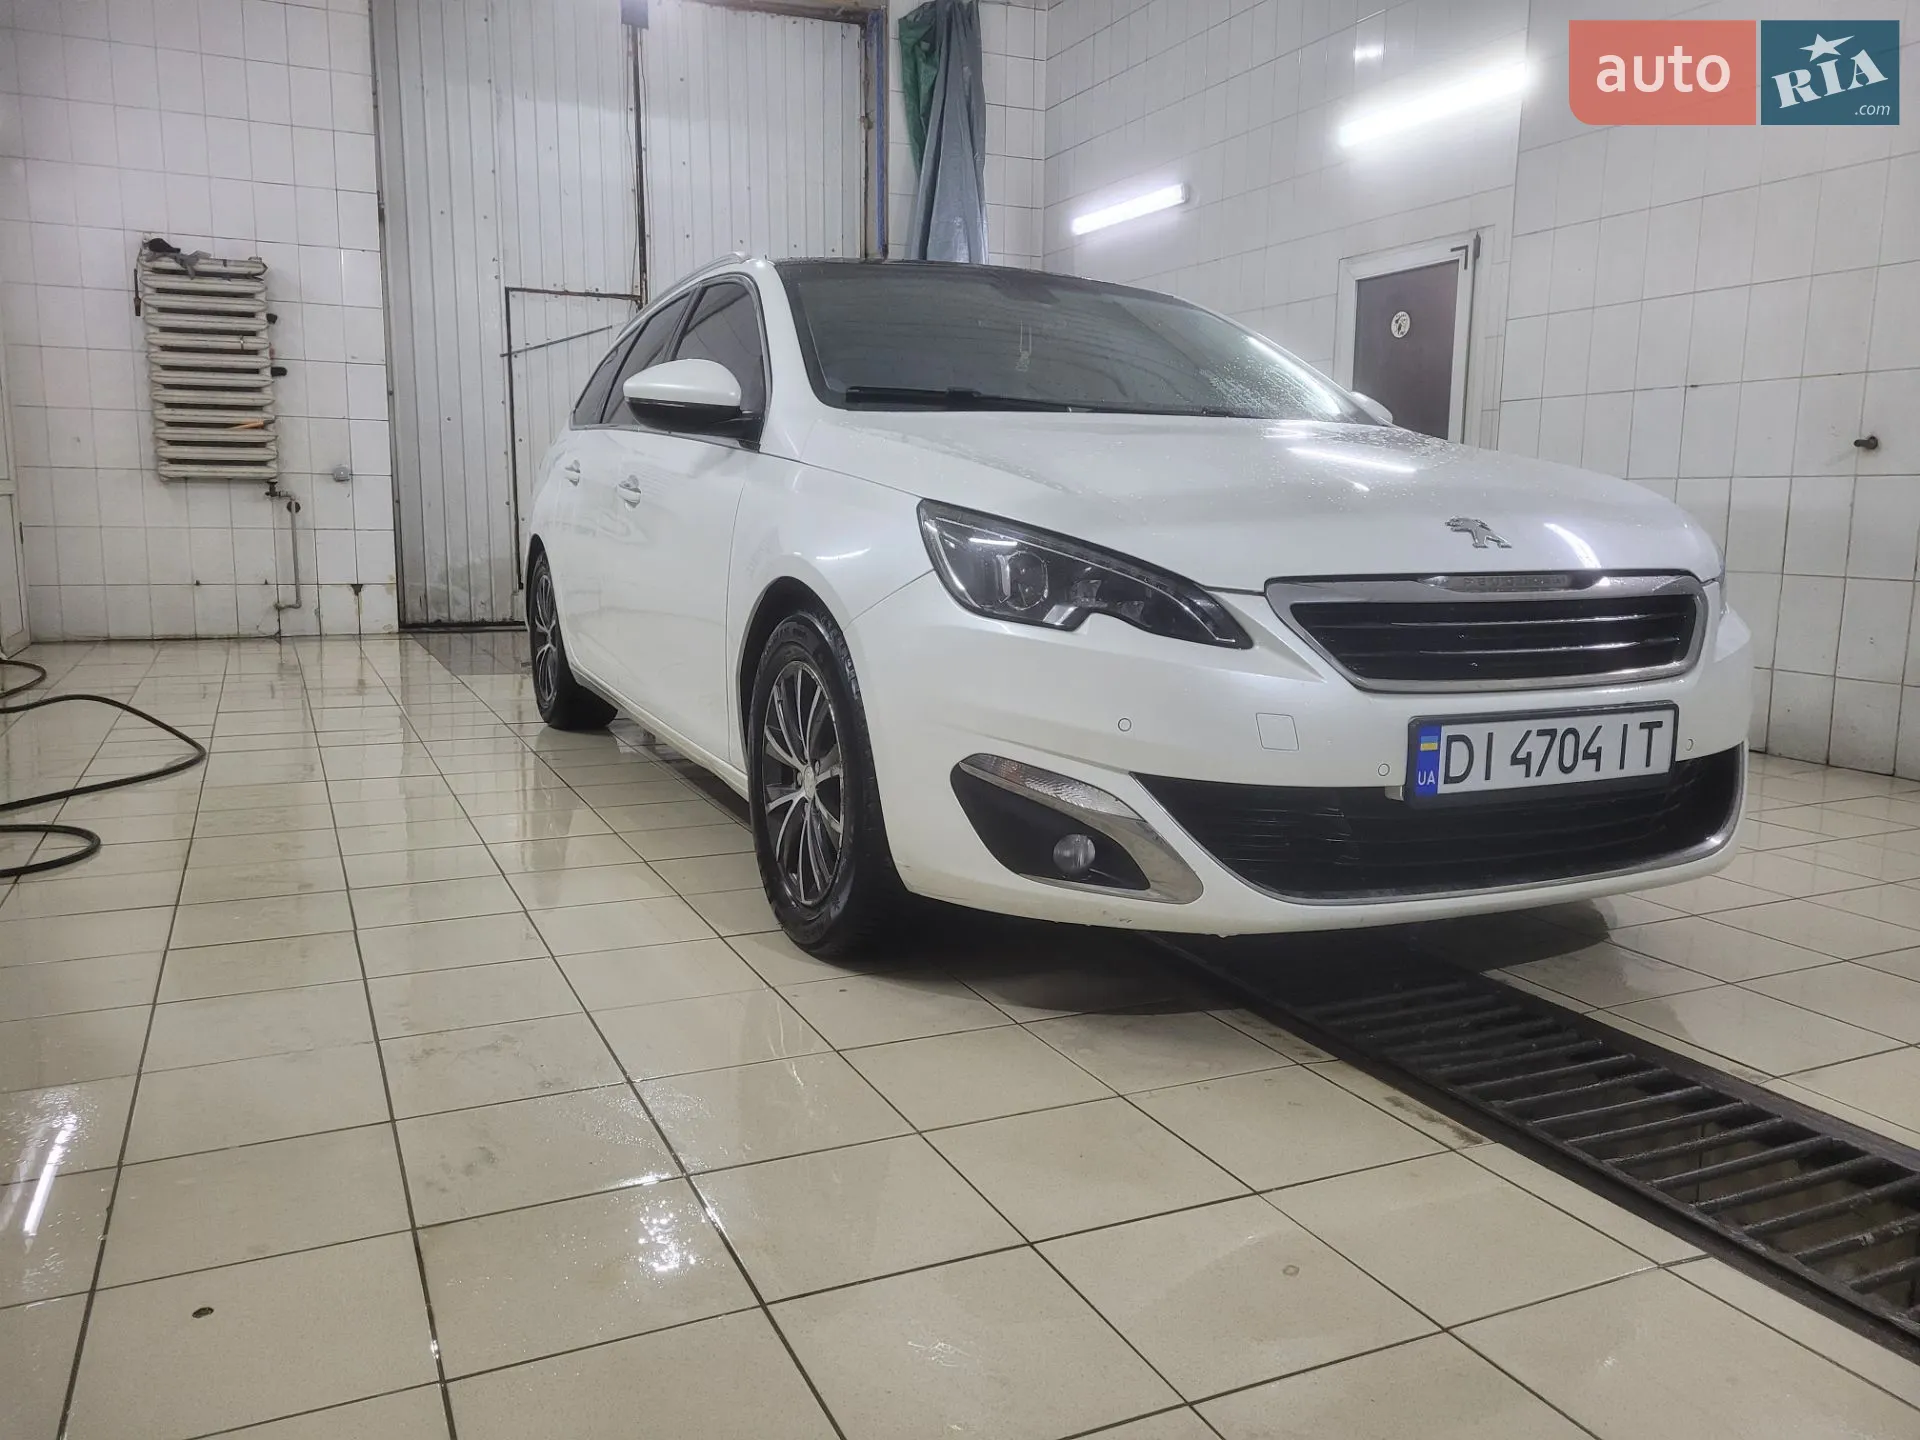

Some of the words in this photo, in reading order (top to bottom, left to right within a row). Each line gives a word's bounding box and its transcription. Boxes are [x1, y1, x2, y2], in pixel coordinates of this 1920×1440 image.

[1443, 732, 1495, 785] DI
[1510, 725, 1603, 778] 4704
[1619, 721, 1664, 771] IT
[1417, 770, 1436, 786] UA
